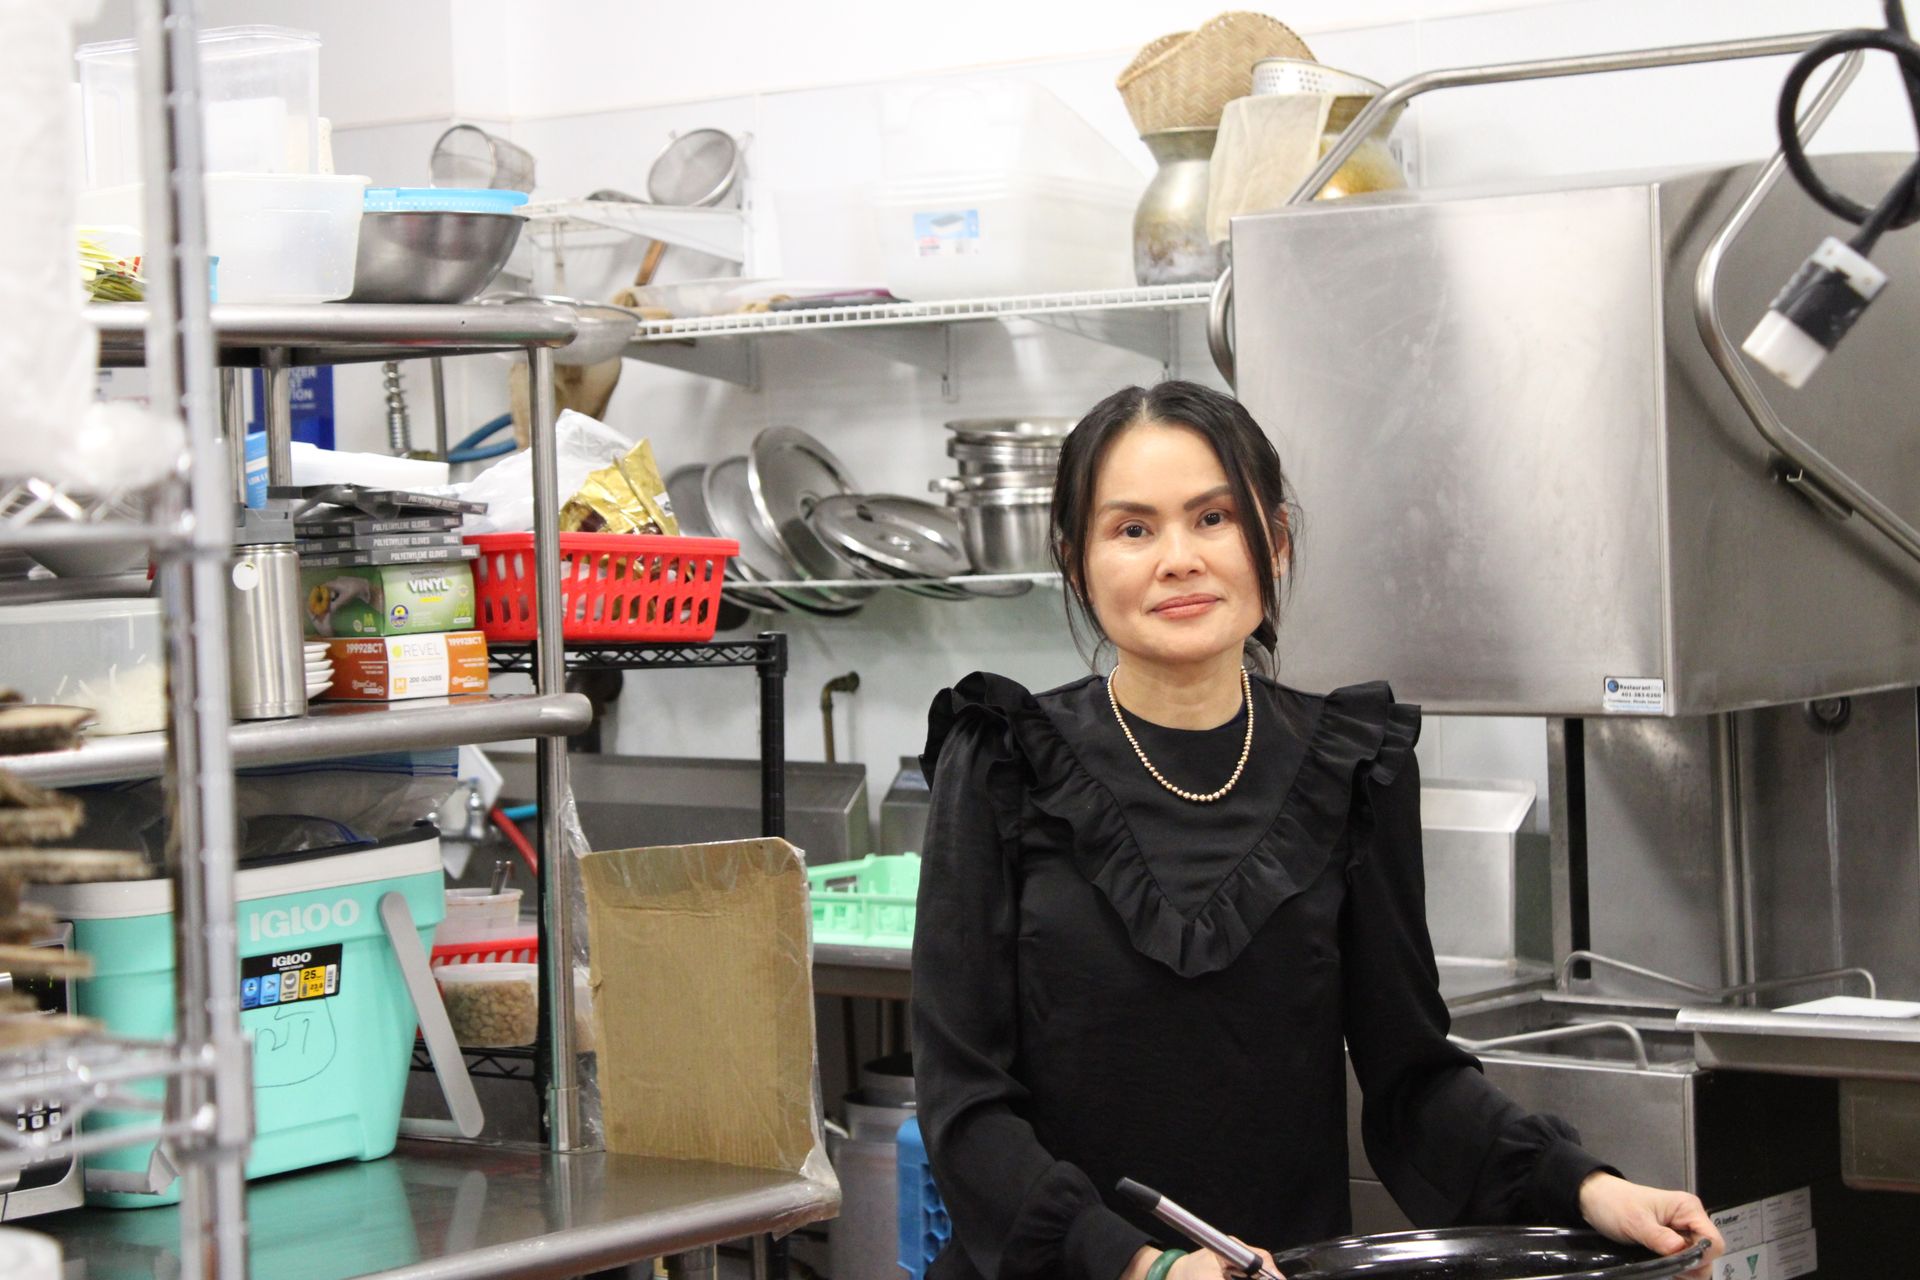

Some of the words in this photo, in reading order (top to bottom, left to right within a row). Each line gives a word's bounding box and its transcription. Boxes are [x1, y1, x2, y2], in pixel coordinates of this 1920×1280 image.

[372, 521, 410, 532] POLYETHYLENE
[411, 519, 430, 529] GLOVES
[373, 537, 410, 547] POLYETHYLENE
[411, 536, 430, 546] GLOVES
[443, 535, 460, 544] SMALL
[390, 551, 428, 561] POLYETHYLENE
[428, 549, 448, 559] GLOVES
[460, 547, 477, 557] SMALL
[408, 577, 449, 594] VINYL
[402, 642, 440, 657] REVEL
[250, 899, 359, 941] IGLOO
[272, 952, 312, 968] IGLOO
[304, 970, 317, 981] 25
